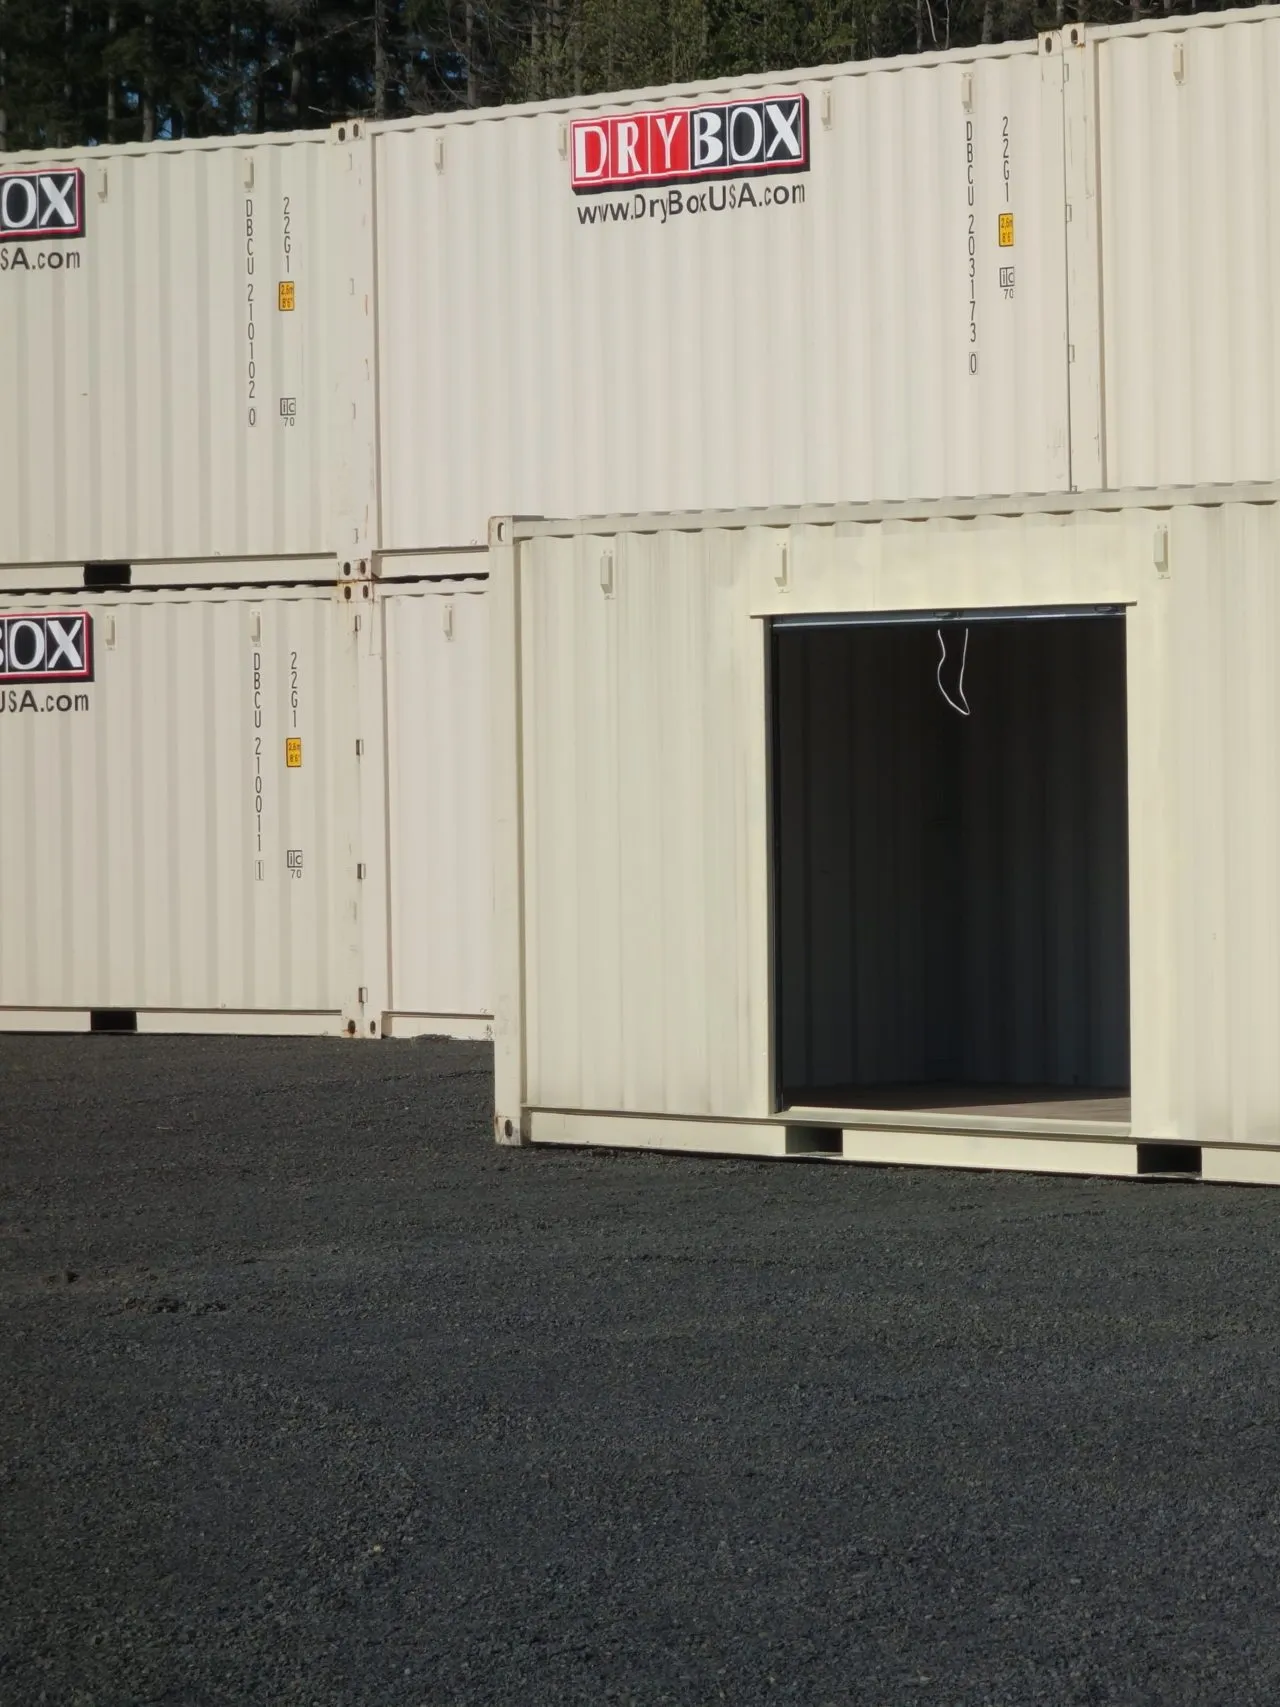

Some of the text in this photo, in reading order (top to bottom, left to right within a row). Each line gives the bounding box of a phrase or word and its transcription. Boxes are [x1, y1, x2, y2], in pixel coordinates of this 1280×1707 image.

[574, 102, 801, 179] DRYBOX
[1002, 116, 1010, 202] 22G1
[283, 196, 291, 273] 22G1
[577, 182, 805, 225] www.DryBoxUSA.com
[966, 120, 977, 373] DBCU 203173 0
[246, 199, 256, 426] DBCU 210102 0
[1004, 289, 1014, 299] 70
[283, 417, 295, 426] 70
[253, 652, 261, 728] DBCU
[290, 651, 298, 728] 22G1
[255, 737, 263, 852] 210011
[290, 869, 302, 879] 70
